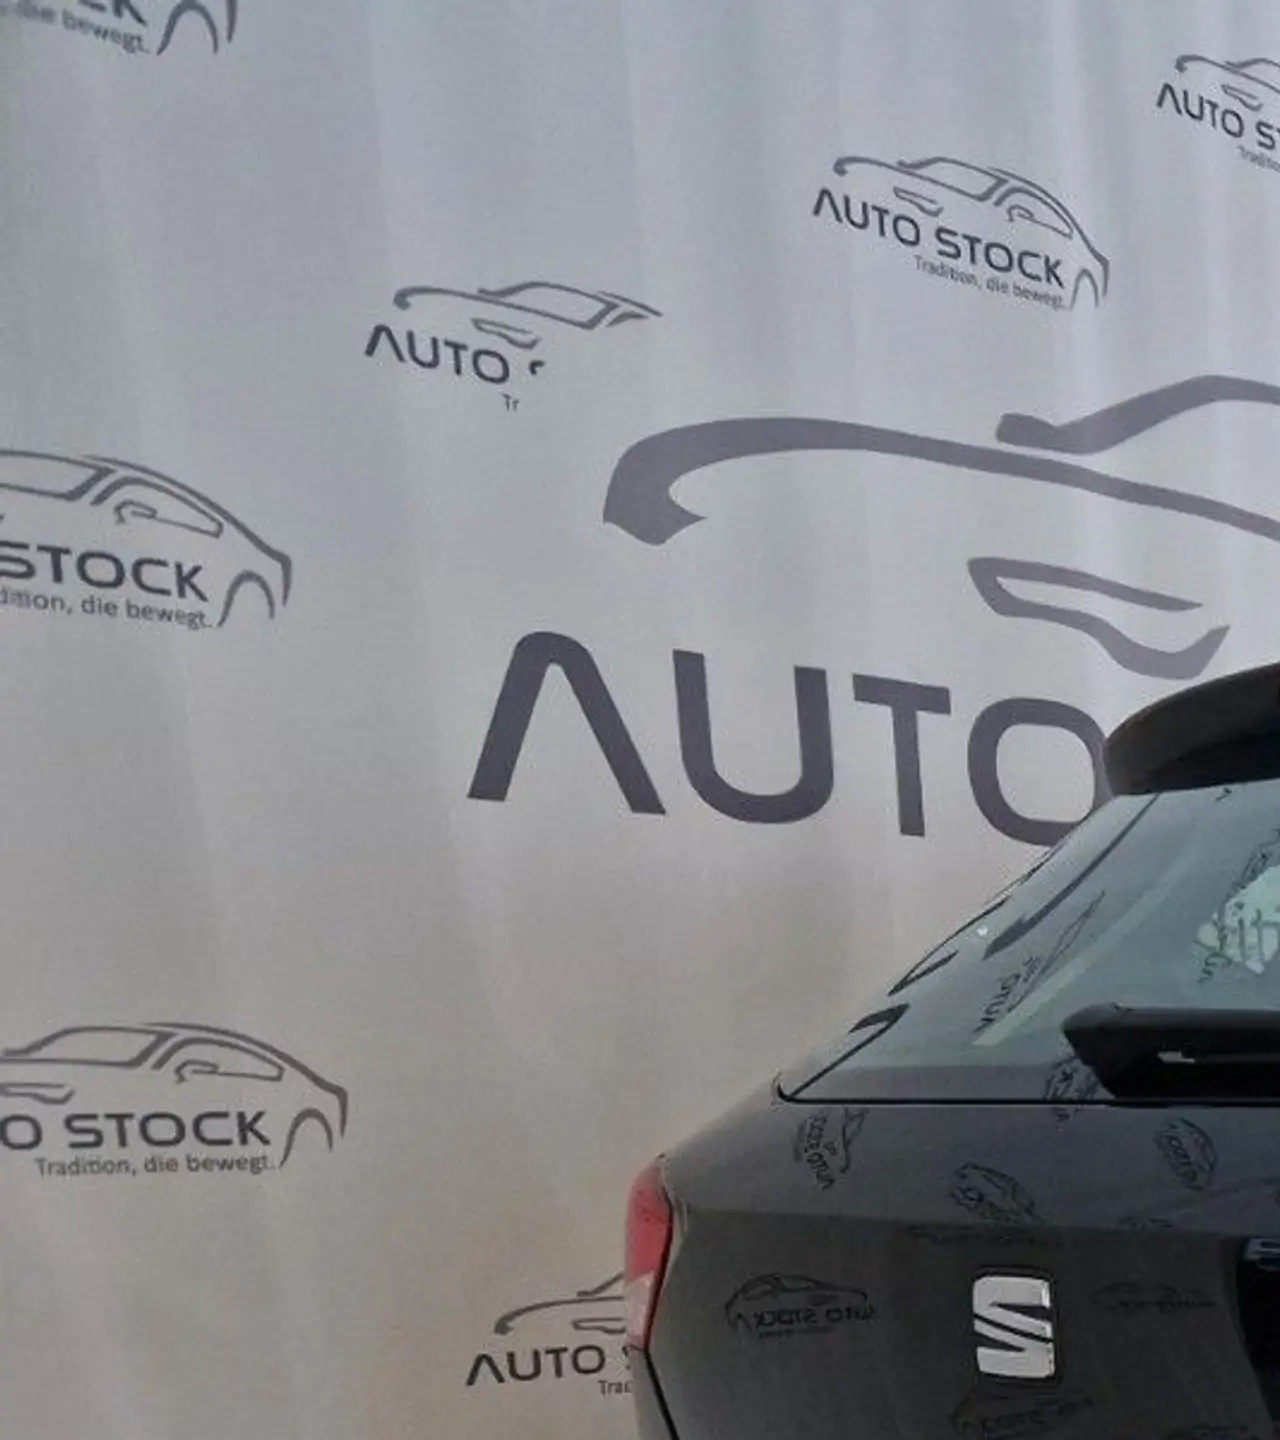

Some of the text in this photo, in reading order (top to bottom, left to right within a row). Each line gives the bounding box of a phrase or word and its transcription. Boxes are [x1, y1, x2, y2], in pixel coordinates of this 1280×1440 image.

[1157, 83, 1244, 138] AUTO
[813, 188, 1065, 289] AUTO STOCK
[364, 325, 510, 384] AUTO
[81, 595, 119, 619] die
[468, 631, 1108, 846] AUTO
[64, 1111, 271, 1149] STOCK
[34, 1156, 137, 1178] Tradition,
[143, 1155, 179, 1174] die
[466, 1344, 606, 1386] AUTO
